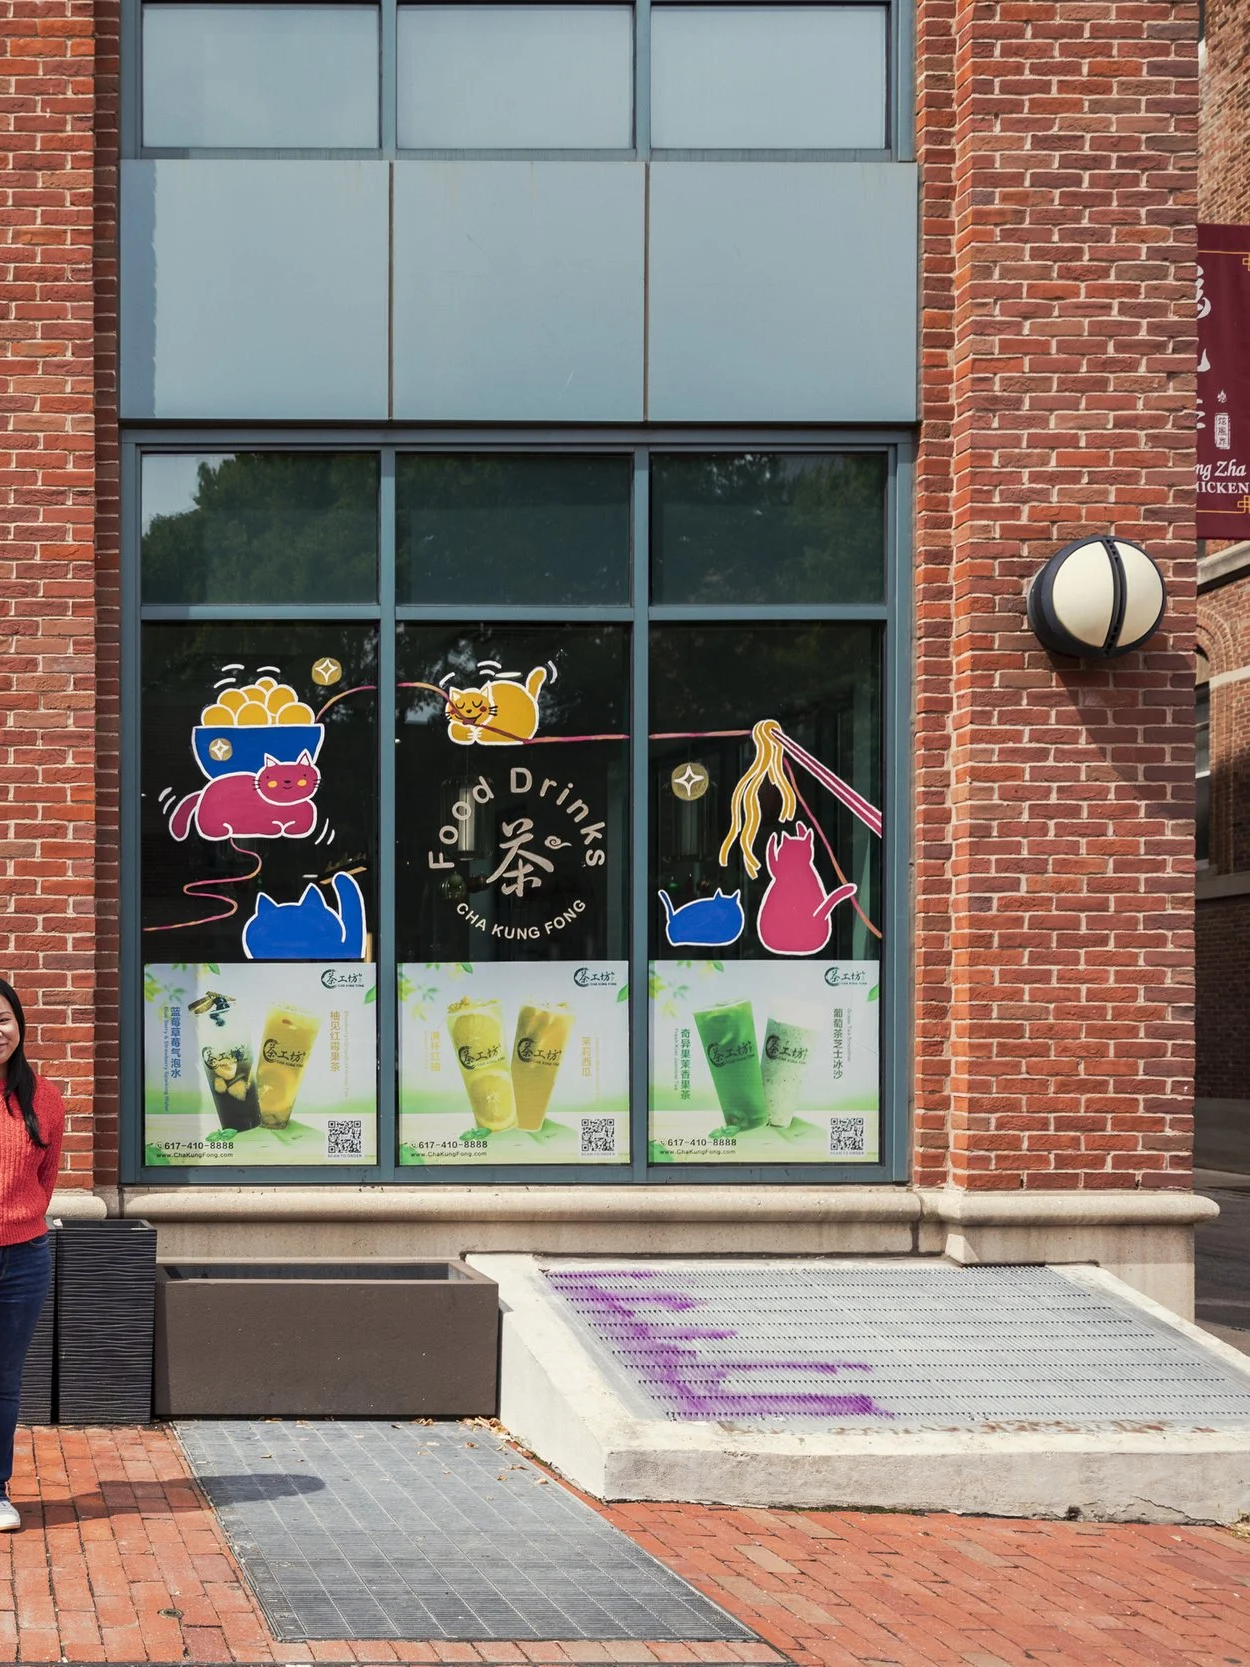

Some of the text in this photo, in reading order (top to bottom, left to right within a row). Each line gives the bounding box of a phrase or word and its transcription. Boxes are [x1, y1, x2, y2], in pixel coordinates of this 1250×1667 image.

[1214, 458, 1246, 477] Zha
[1196, 481, 1250, 494] ICKEN
[428, 767, 606, 870] Food Drinks
[486, 817, 555, 898] 茶
[456, 899, 586, 940] CHA KUNG FONG
[170, 1006, 181, 1078] 蓝莓草莓气泡水
[833, 1008, 843, 1080] 葡萄茶芝士冰沙
[164, 1141, 234, 1150] 617-410-8888
[418, 1140, 488, 1149] 617-410-8888
[667, 1138, 737, 1147] 617-410-8888
